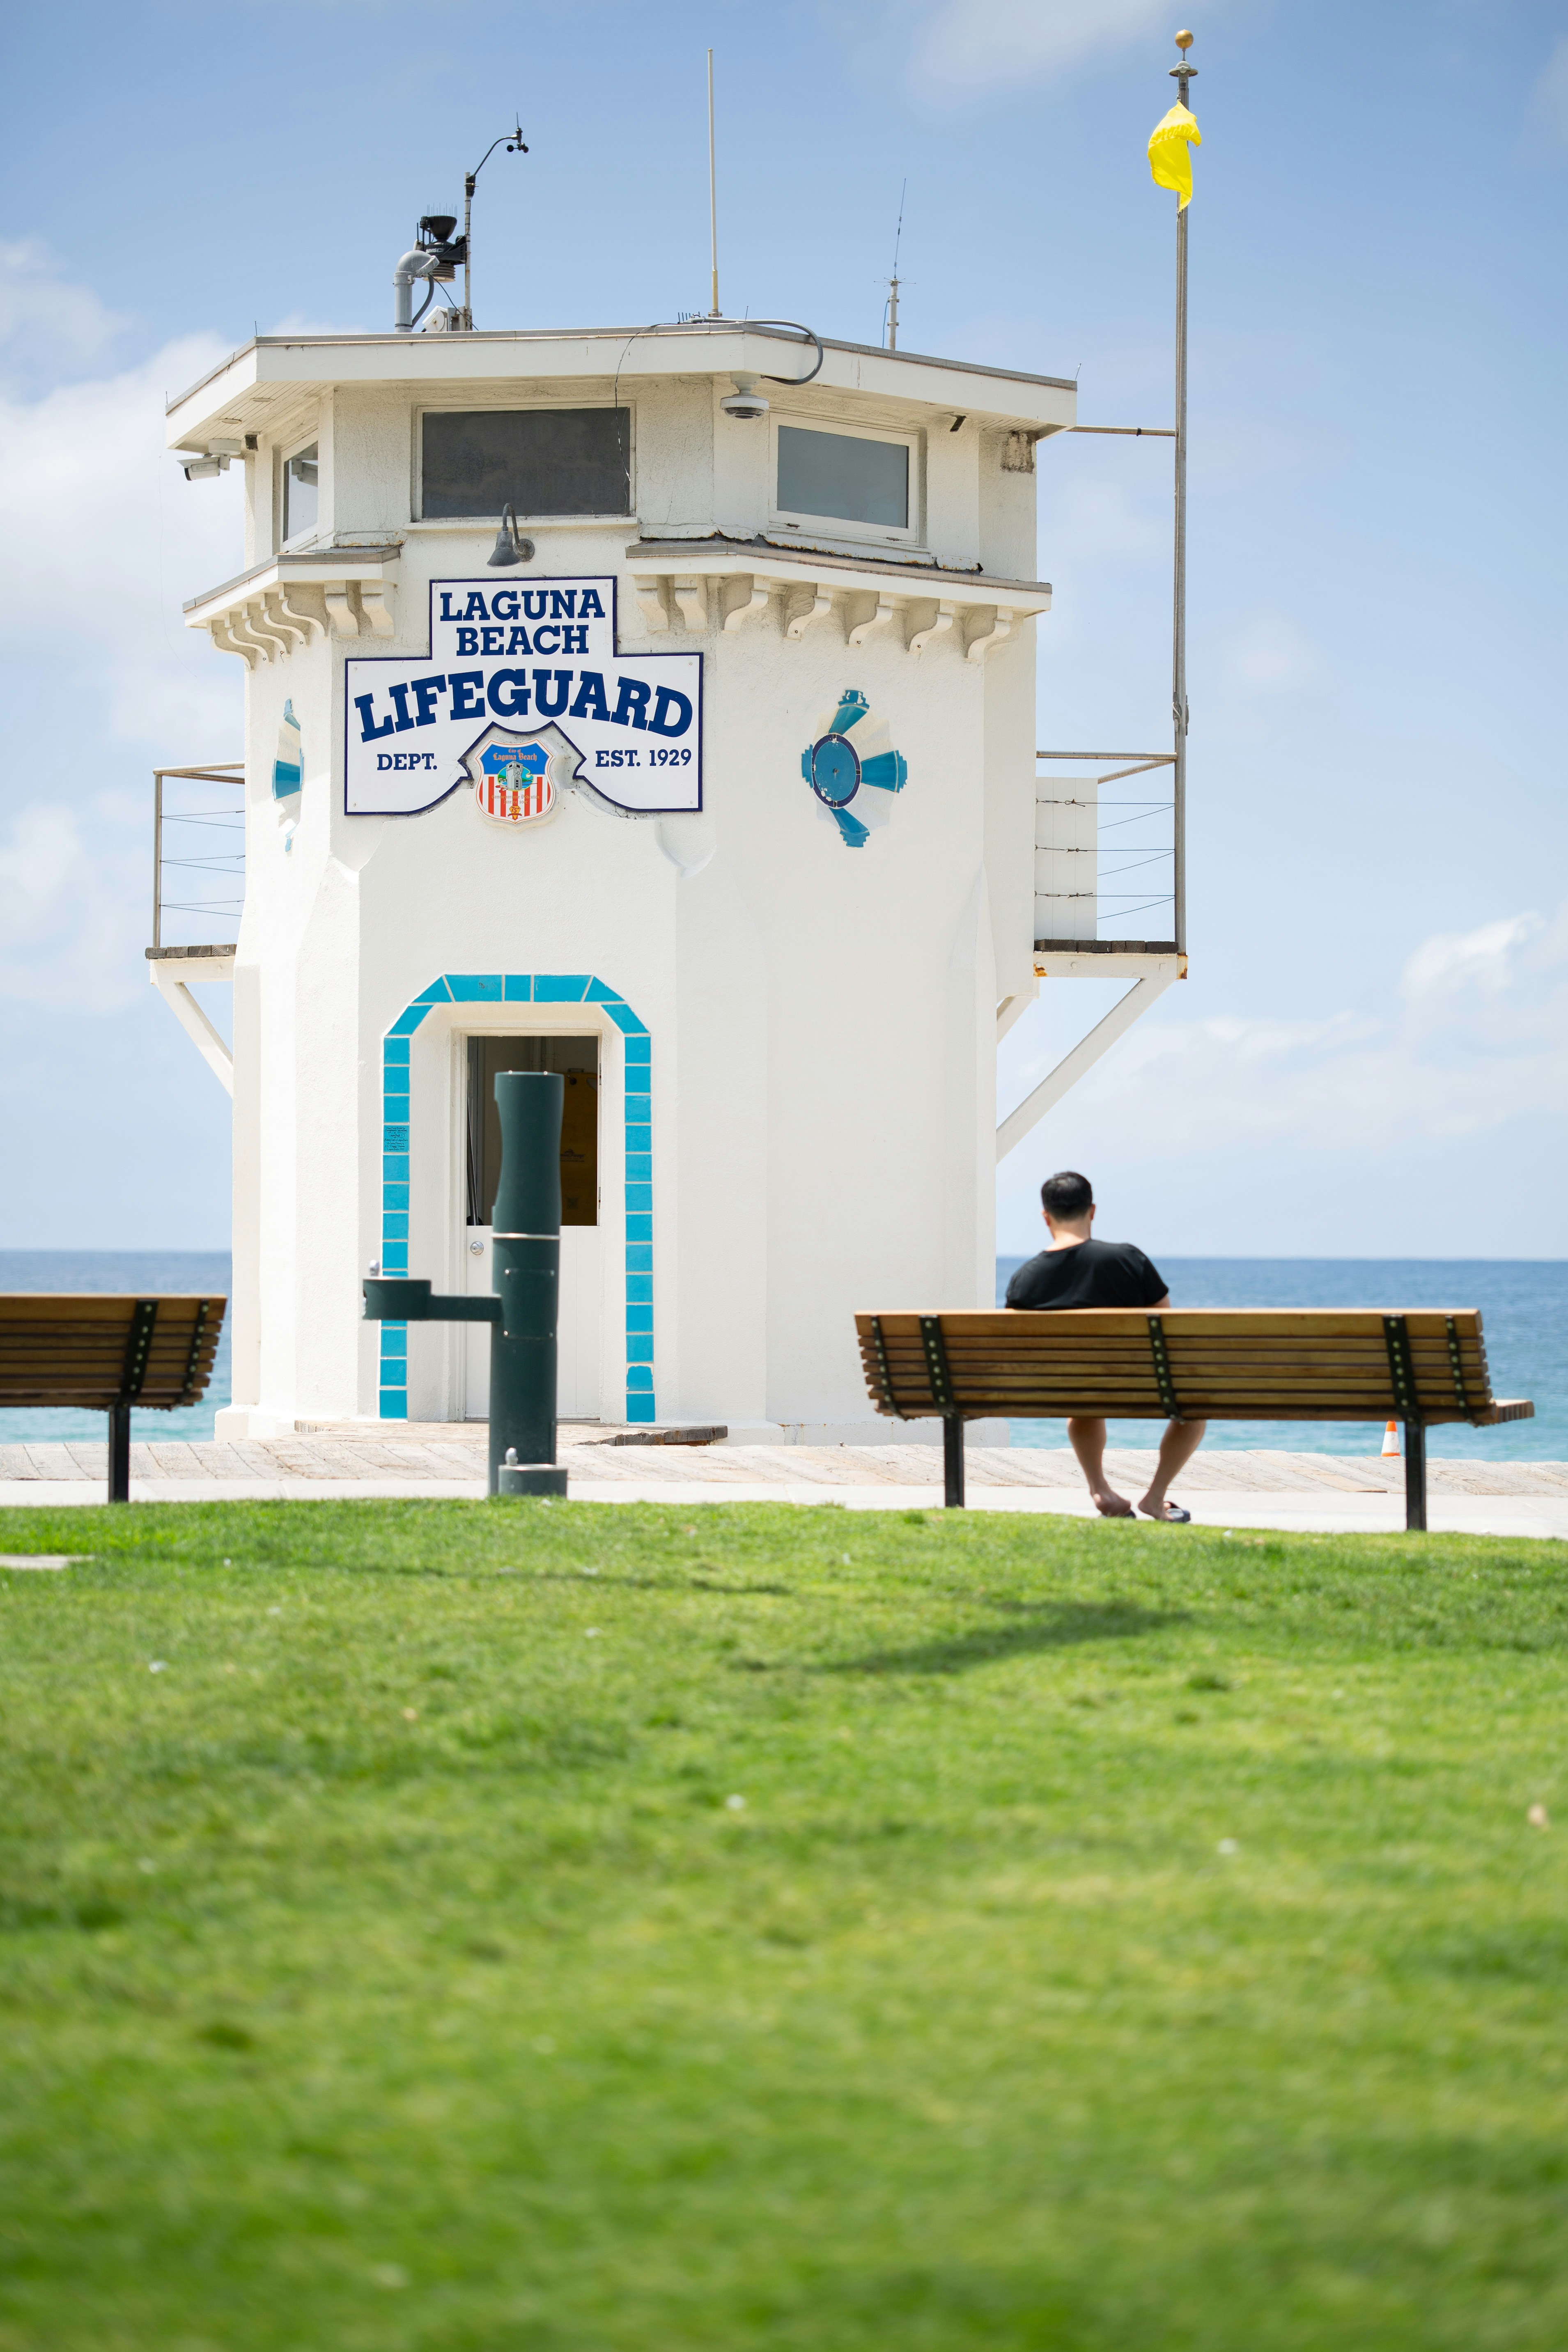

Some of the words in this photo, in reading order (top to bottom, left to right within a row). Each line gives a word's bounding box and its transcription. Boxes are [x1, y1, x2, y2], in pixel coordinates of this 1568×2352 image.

[440, 589, 606, 622] LAGUNA
[456, 624, 589, 656] BEACH
[354, 668, 693, 743] LIFEGUARD
[377, 753, 437, 771] DEPT.
[493, 753, 516, 761] Laguna
[519, 753, 537, 761] Beach
[595, 750, 641, 767] EST.
[650, 748, 691, 766] 1929
